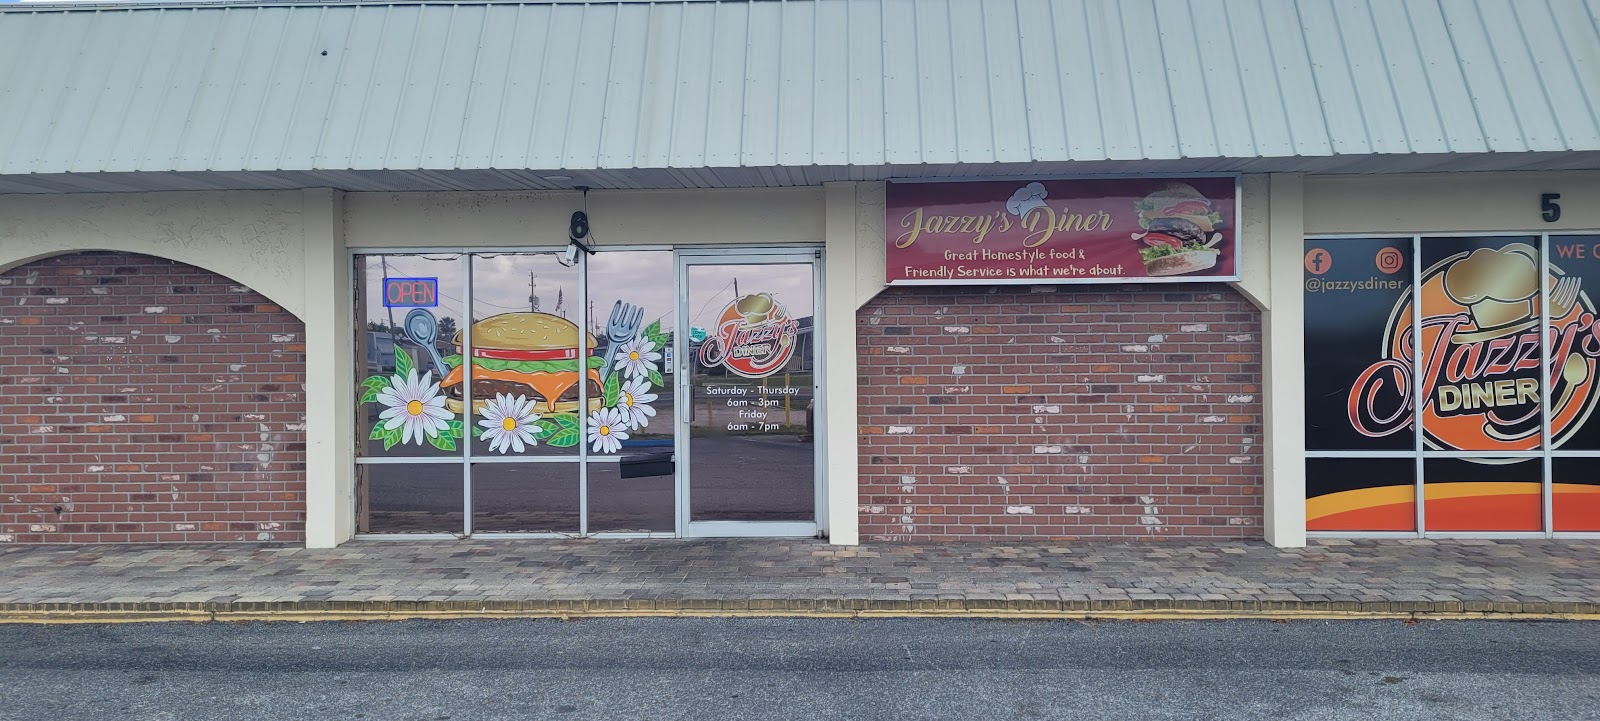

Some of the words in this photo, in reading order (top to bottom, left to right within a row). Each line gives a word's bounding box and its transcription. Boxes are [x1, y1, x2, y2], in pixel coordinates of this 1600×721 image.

[1541, 193, 1561, 222] 5
[895, 207, 1013, 249] Jazzy's
[1022, 206, 1113, 248] Diner
[944, 249, 979, 261] Great
[982, 249, 1046, 263] Homestyle
[1049, 248, 1076, 260] food
[1078, 249, 1086, 260] &
[1556, 244, 1585, 259] WE
[905, 265, 954, 280] Friendly
[957, 266, 1003, 277] Service
[1006, 266, 1017, 276] is
[1019, 265, 1050, 276] what
[1052, 265, 1086, 276] we're
[1089, 264, 1126, 276] about.
[1305, 276, 1404, 293] @jazzysdiner
[387, 281, 435, 304] OPEN
[699, 319, 800, 368] Jazzy's
[733, 343, 772, 358] DINER
[706, 386, 747, 397] Saturday
[757, 385, 800, 396] Thursday
[1437, 377, 1541, 412] DINER
[726, 398, 748, 407] 6am
[758, 398, 779, 409] 3pm
[739, 409, 768, 421] Friday
[727, 422, 748, 430] 6am
[758, 422, 780, 433] 7pm
